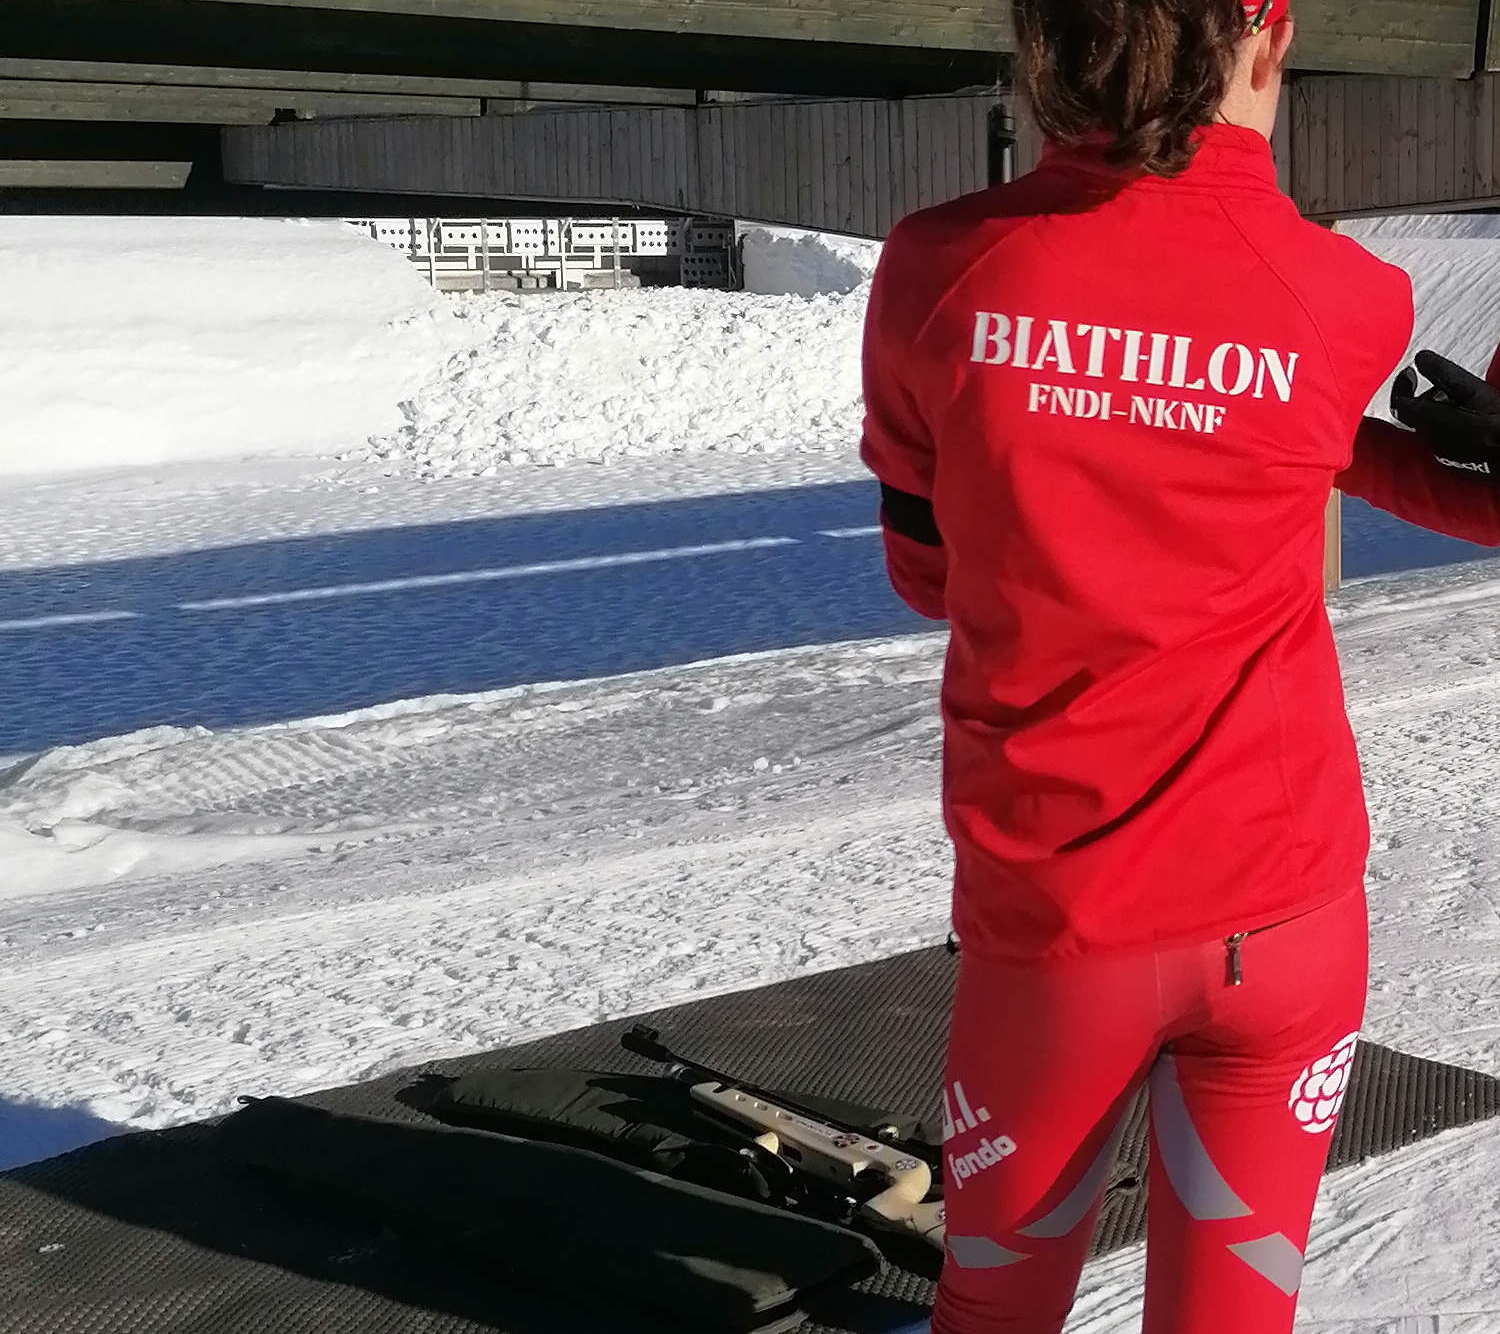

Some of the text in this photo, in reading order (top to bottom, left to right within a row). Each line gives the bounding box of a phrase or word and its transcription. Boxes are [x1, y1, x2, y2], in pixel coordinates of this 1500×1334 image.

[970, 310, 1300, 404] BIATHLON
[1028, 382, 1227, 435] FNDI-NKNF
[947, 1135, 1018, 1190] fondo
